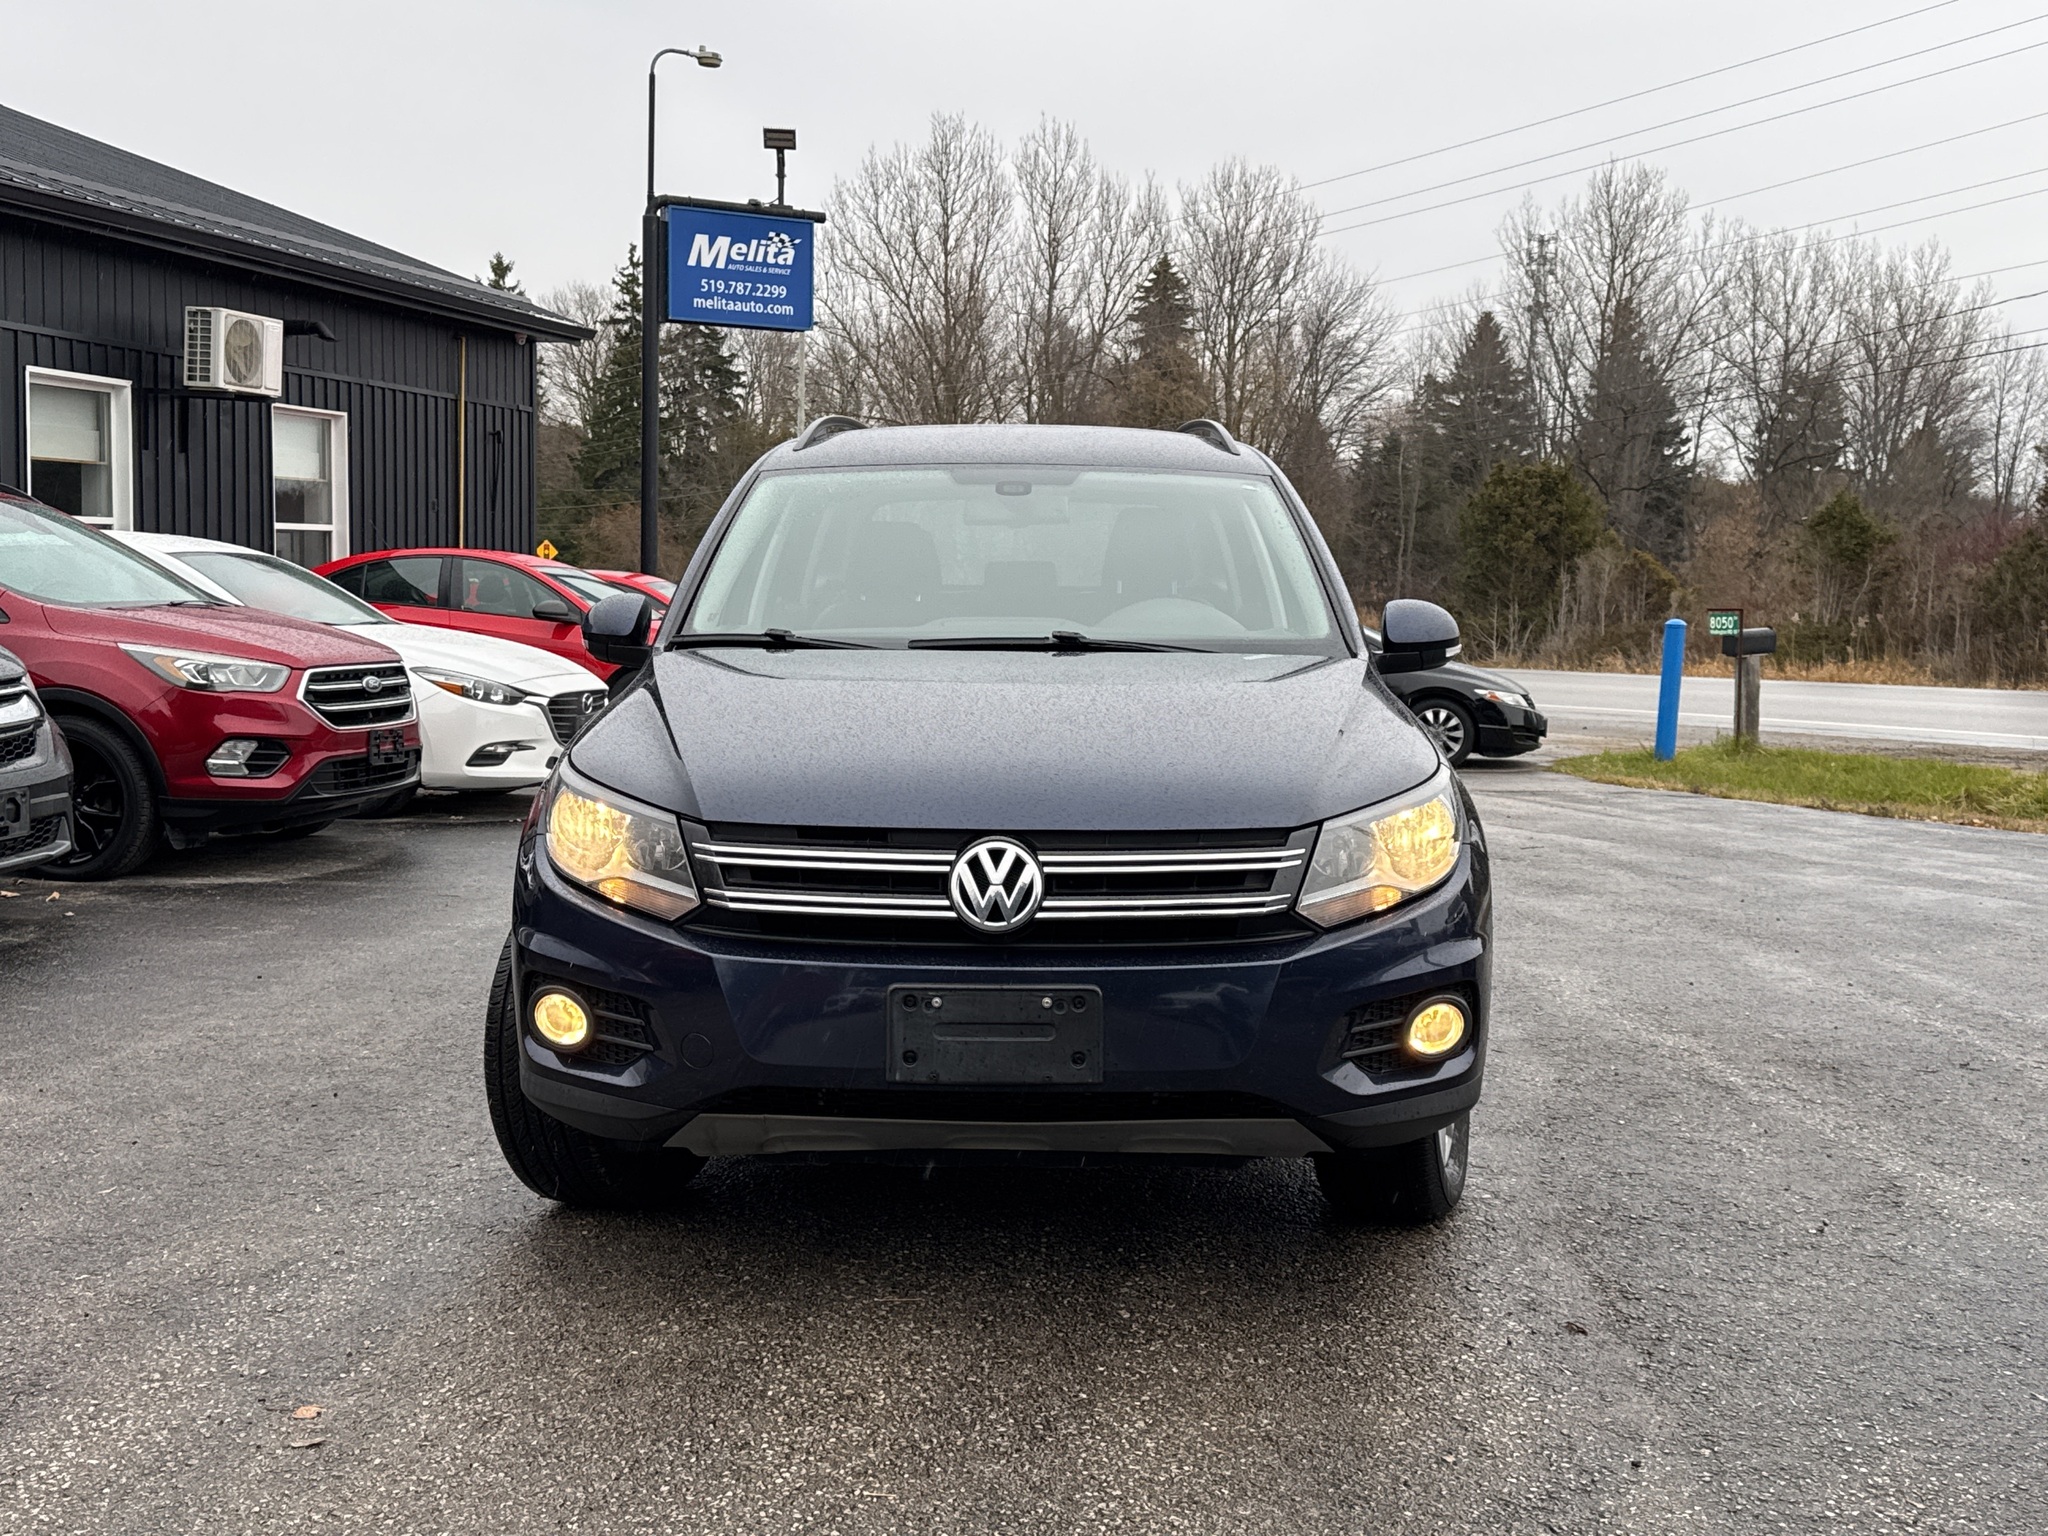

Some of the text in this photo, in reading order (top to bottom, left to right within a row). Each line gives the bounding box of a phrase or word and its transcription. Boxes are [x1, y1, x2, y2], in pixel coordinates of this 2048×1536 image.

[687, 233, 796, 269] Melita
[745, 265, 762, 273] SALES
[768, 267, 792, 275] SERVICE
[700, 278, 787, 299] 519.787.2299
[693, 296, 794, 315] melitaauto.com
[1710, 616, 1734, 629] 8050
